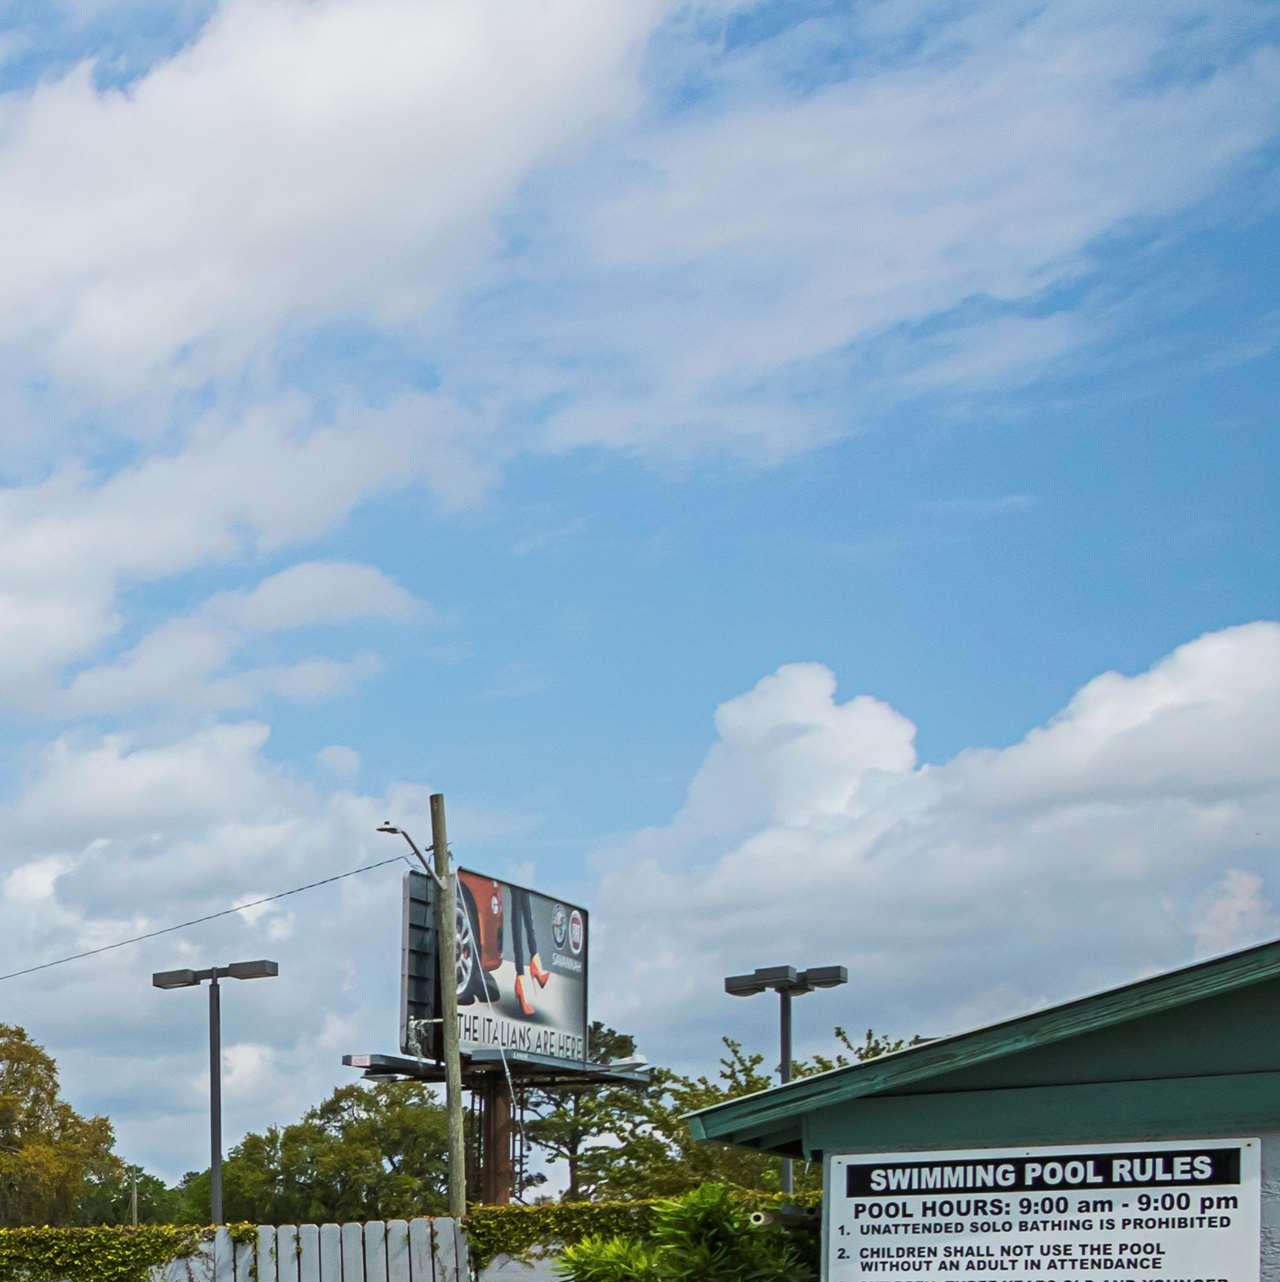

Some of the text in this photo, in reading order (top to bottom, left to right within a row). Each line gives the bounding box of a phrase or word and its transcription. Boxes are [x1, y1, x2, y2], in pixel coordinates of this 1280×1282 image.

[457, 1013, 583, 1061] THE ITALIANS ARE HERE
[871, 1156, 1211, 1190] SWIMMING POOL RULES
[854, 1201, 914, 1219] POOL
[922, 1199, 1010, 1217] HOURS:
[1019, 1197, 1069, 1215] 9:00
[1077, 1200, 1113, 1213] am
[1137, 1193, 1190, 1211] 9:00
[1200, 1196, 1238, 1214] pm
[838, 1216, 1231, 1235] 1. UNATTENDED SOLO BATHING IS PROHIBITED
[837, 1243, 1165, 1259] 2. CHILDREN SHALL NOT USE THE POOL
[860, 1258, 1162, 1272] WITHOUT AN ADULT IN ATTENDANCE
